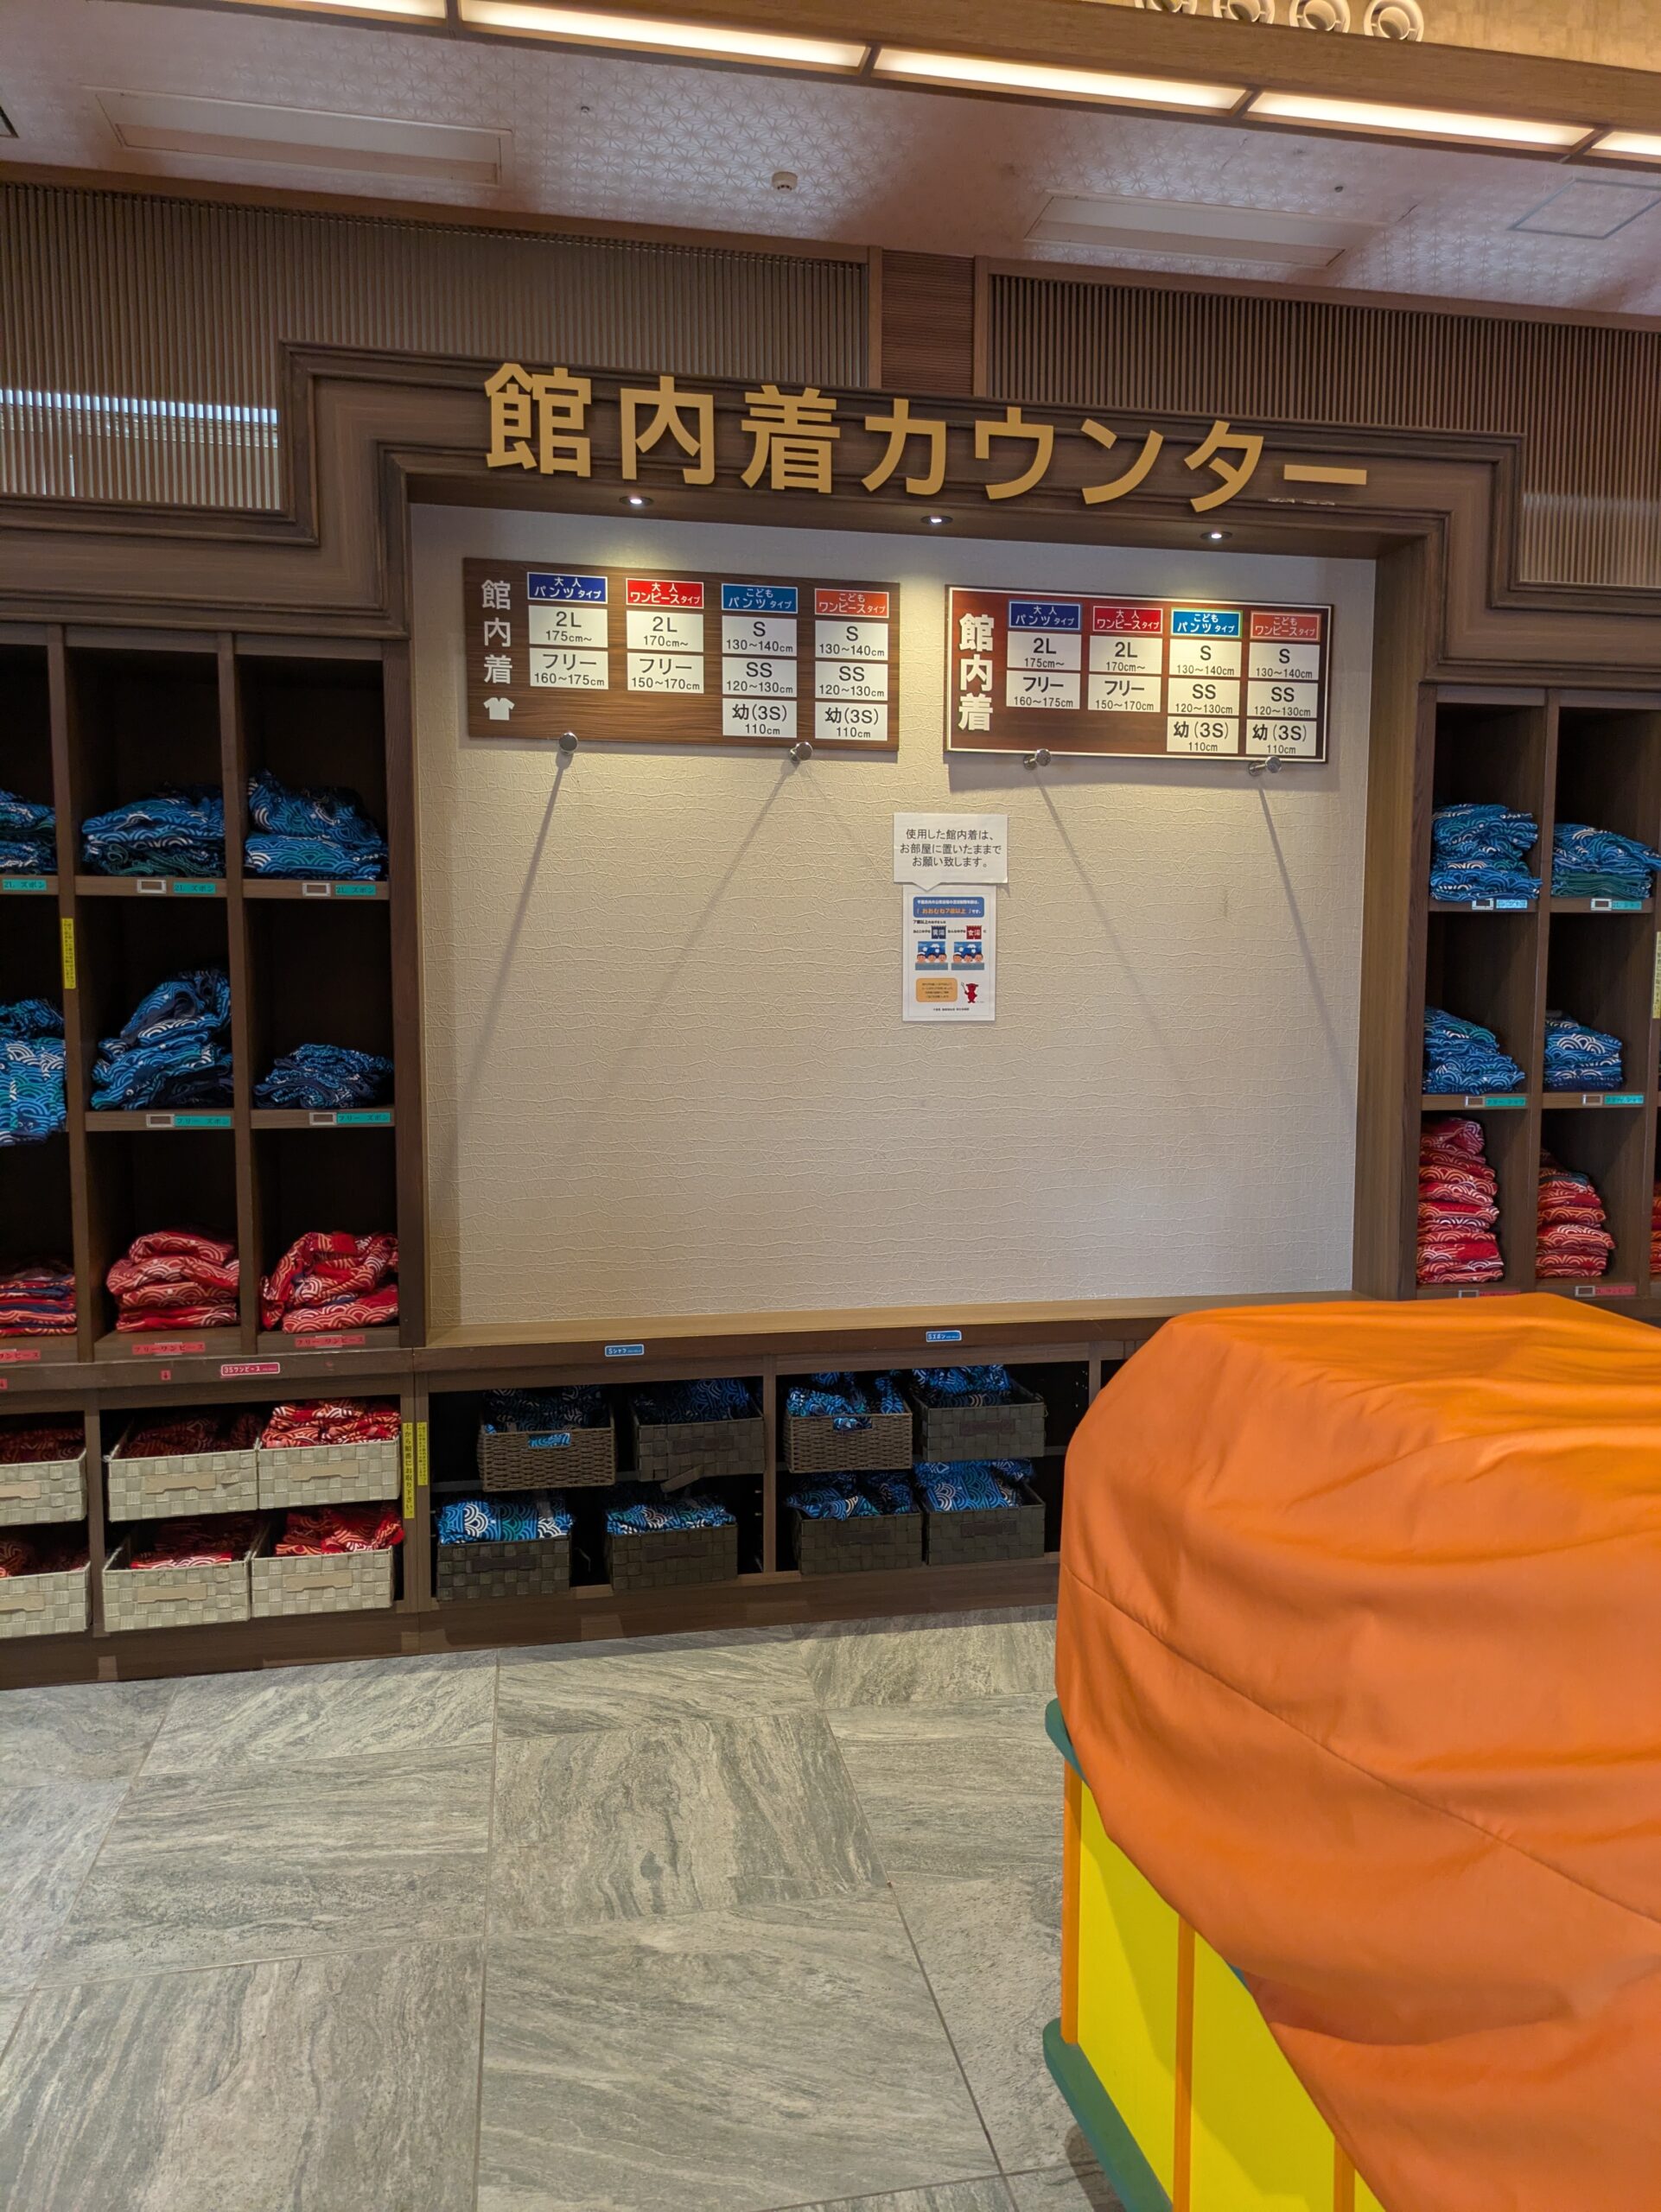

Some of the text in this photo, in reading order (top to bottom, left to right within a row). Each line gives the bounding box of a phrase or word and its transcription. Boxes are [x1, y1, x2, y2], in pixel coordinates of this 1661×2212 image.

[484, 362, 1367, 512] 館内着カウンター
[554, 577, 582, 588] 大人
[652, 582, 678, 593] 大人
[630, 592, 701, 604] ワンピースタイプ
[746, 588, 773, 597] こども
[839, 593, 865, 602] こども
[819, 602, 886, 613] ワンピースタイプ
[1116, 610, 1139, 619] 大人
[556, 611, 582, 627] 2L
[652, 616, 678, 632] 2L
[1097, 619, 1159, 630] ワンピースタイプ
[1193, 613, 1219, 623] こども
[1273, 617, 1297, 626] こども
[481, 580, 513, 684] 館内着
[753, 621, 766, 637] S
[846, 626, 859, 641] S
[1255, 626, 1315, 636] ワンピースタイプ
[1033, 638, 1057, 654] 2L
[1115, 642, 1138, 658] 2L
[1200, 645, 1212, 660] S
[543, 653, 597, 671] フリー
[1279, 648, 1290, 664] S
[640, 658, 692, 675] フリー
[746, 662, 773, 678] SS
[838, 666, 865, 682] SS
[958, 613, 994, 731] 館内着
[1023, 677, 1064, 692] フリー
[1104, 680, 1144, 696] フリー
[1193, 683, 1216, 699] SS
[1271, 686, 1295, 702] SS
[732, 703, 787, 721] 幼(3S)
[825, 708, 879, 725] 幼(3S)
[745, 724, 780, 734] 110cm
[837, 727, 871, 738] 110cm
[1189, 742, 1218, 752] 110cm
[1267, 745, 1296, 754] 110cm
[906, 829, 993, 841] 使用した館内着は、
[900, 843, 1002, 855] お部屋に置いたままで
[912, 856, 987, 868] お願い致します。
